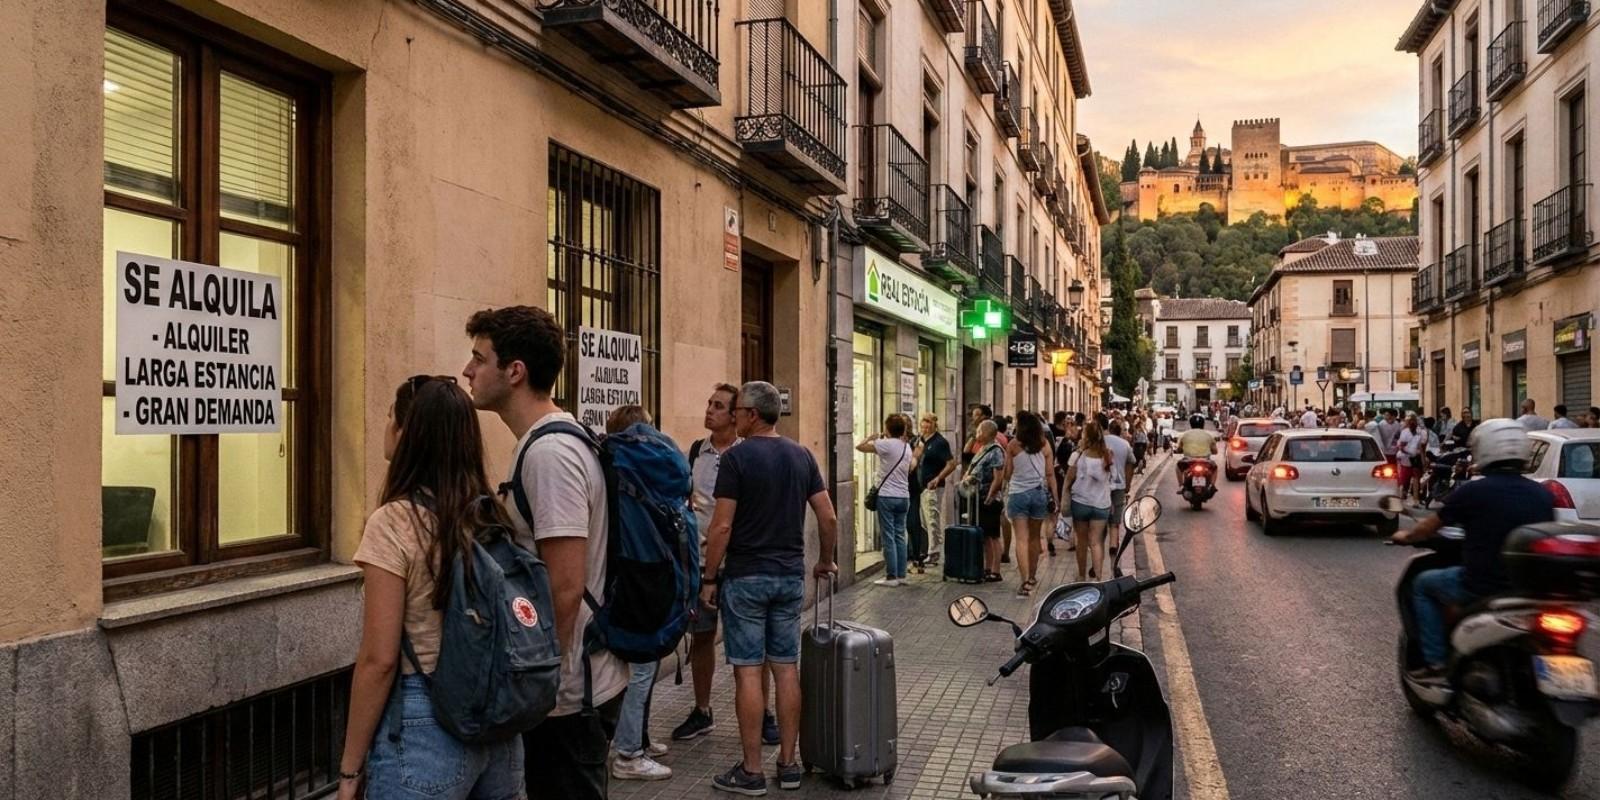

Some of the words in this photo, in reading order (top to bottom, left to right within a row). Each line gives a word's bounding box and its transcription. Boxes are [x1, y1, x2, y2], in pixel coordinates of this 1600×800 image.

[124, 262, 160, 306] SE
[169, 269, 277, 320] ALQUILA
[164, 322, 250, 354] ALQUILER
[581, 332, 595, 358] SE
[598, 335, 640, 362] ALQUILA
[125, 357, 189, 387] LARGA
[195, 361, 276, 390] ESTANCIA
[136, 396, 188, 425] GRAN
[195, 398, 275, 425] DEMANDA
